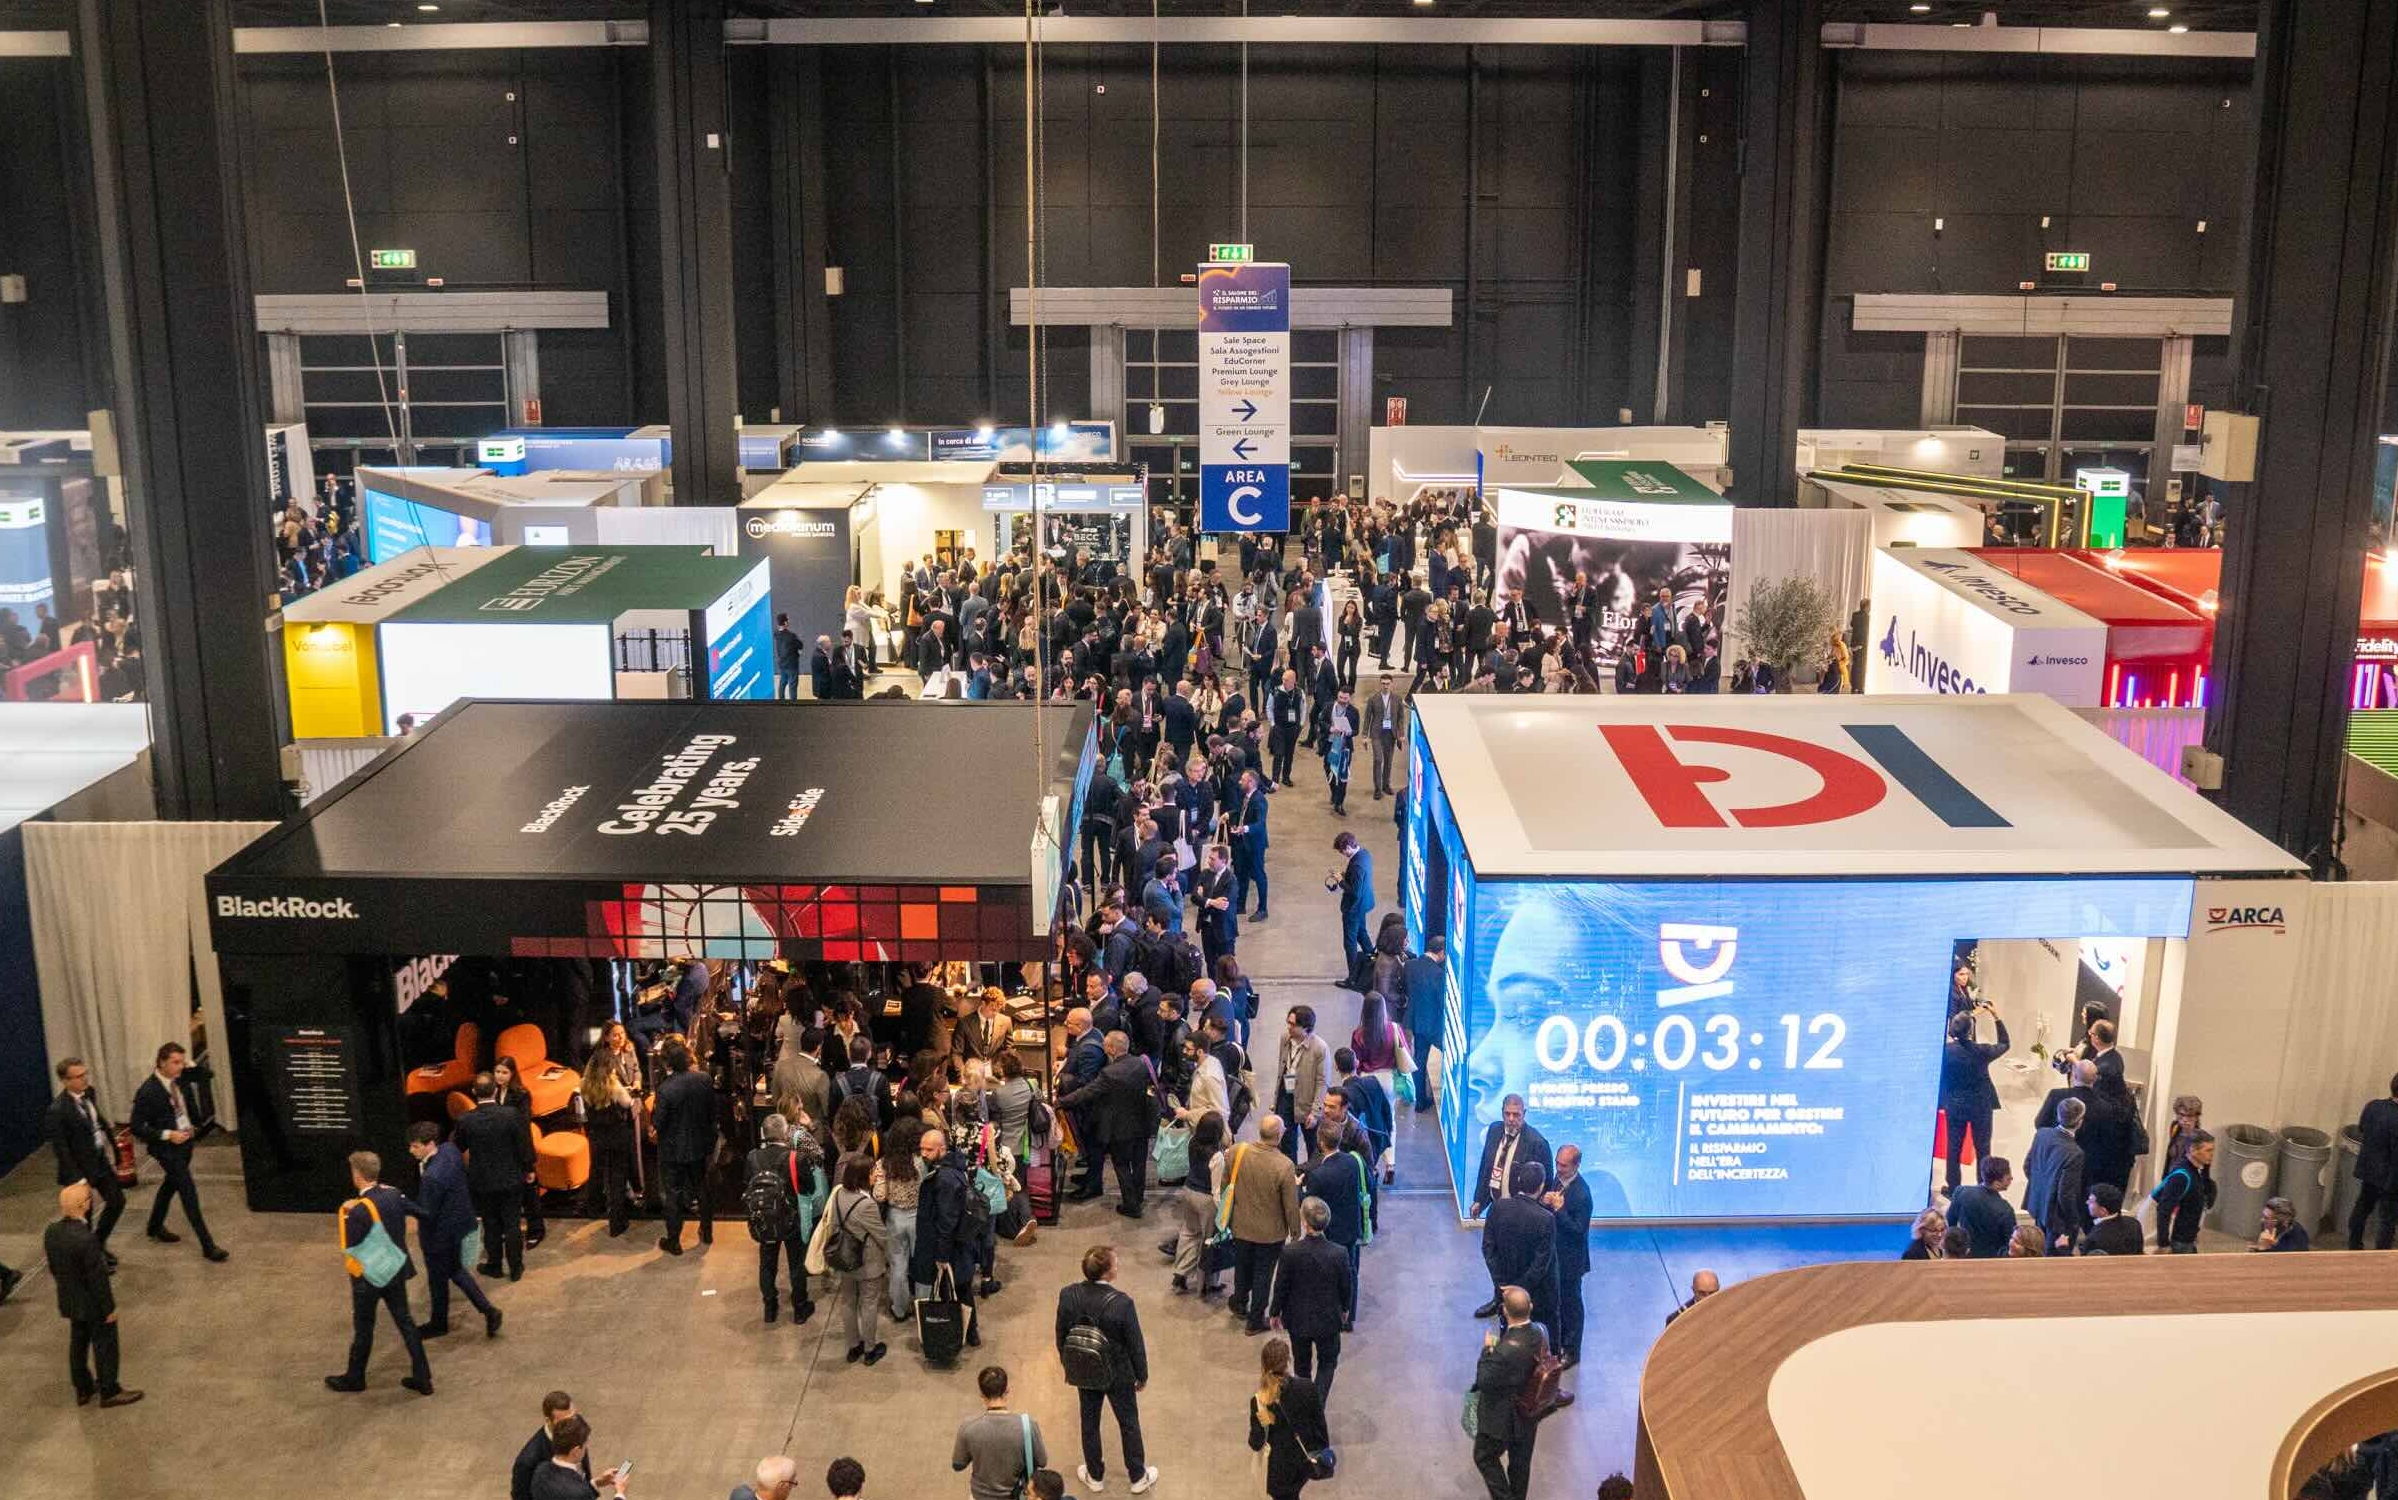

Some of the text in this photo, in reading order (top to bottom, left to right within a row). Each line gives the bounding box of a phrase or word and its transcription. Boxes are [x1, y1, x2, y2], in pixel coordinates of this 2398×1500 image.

[1212, 296, 1258, 304] RISPARMIO
[1223, 336, 1267, 345] Sale Space
[1210, 347, 1279, 356] Sala Assogestioni
[1212, 368, 1278, 377] Premium Lounge
[1220, 378, 1270, 388] Grey Lounge
[1244, 389, 1273, 398] Lounge
[1216, 427, 1275, 438] Green Lounge
[1225, 471, 1266, 483] AREA
[1228, 486, 1263, 526] C
[750, 522, 835, 532] medanum
[341, 562, 459, 606] Vontobel
[1949, 574, 2041, 615] Invesco
[293, 641, 353, 652] Vobel
[2045, 655, 2088, 665] Invesco
[597, 734, 737, 836] Celebrating
[655, 810, 718, 836] 25
[690, 757, 761, 809] years.
[217, 896, 360, 918] BlackRock.
[2228, 908, 2284, 923] ARCA
[1691, 1094, 1766, 1107] INVESTIRE
[1690, 1107, 1844, 1121] FUTURO PER GESTIRE
[1689, 1123, 1703, 1135] IL
[1689, 1142, 1767, 1154] IL RISPARMIO
[1689, 1155, 1742, 1167] NELL'ERA
[1688, 1168, 1788, 1180] DELL'INCERTEZZA
